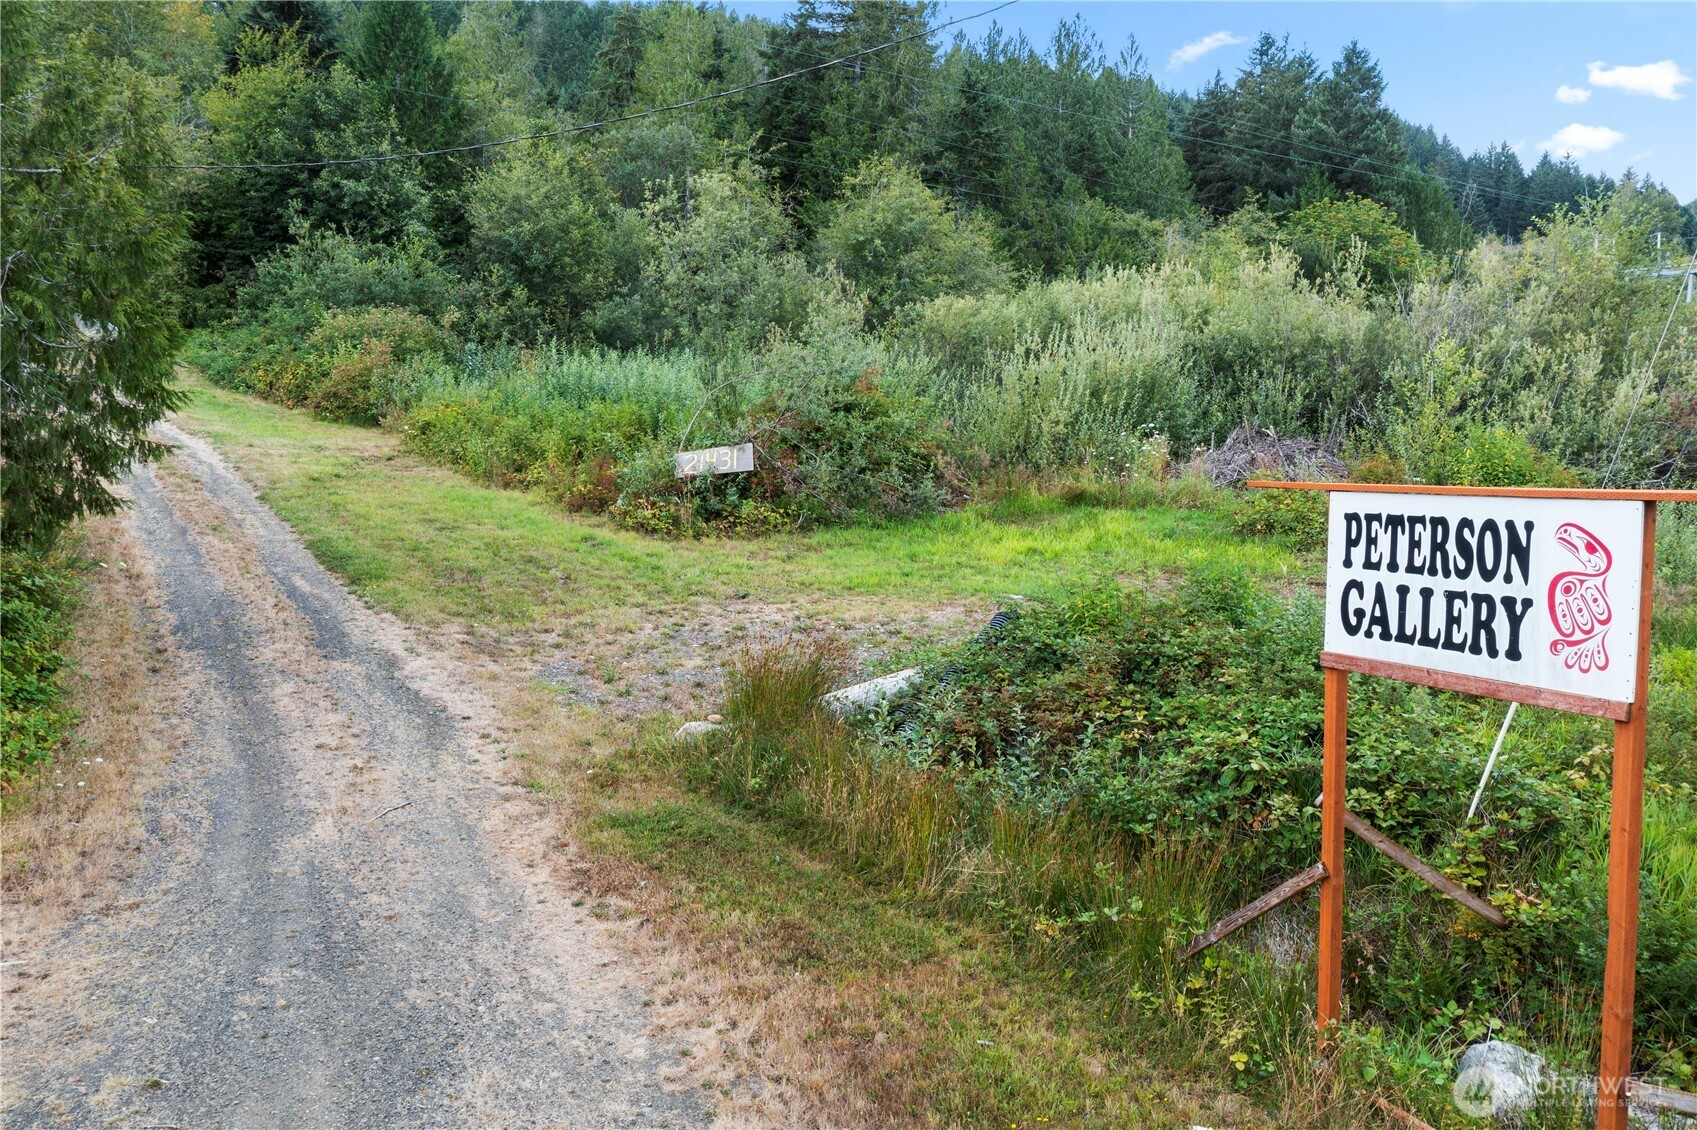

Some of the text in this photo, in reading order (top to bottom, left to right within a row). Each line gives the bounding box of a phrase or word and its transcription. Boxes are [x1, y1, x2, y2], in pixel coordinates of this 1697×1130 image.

[683, 448, 737, 474] 21431
[1343, 512, 1534, 586] PETERSON
[1341, 578, 1533, 662] GALLERY
